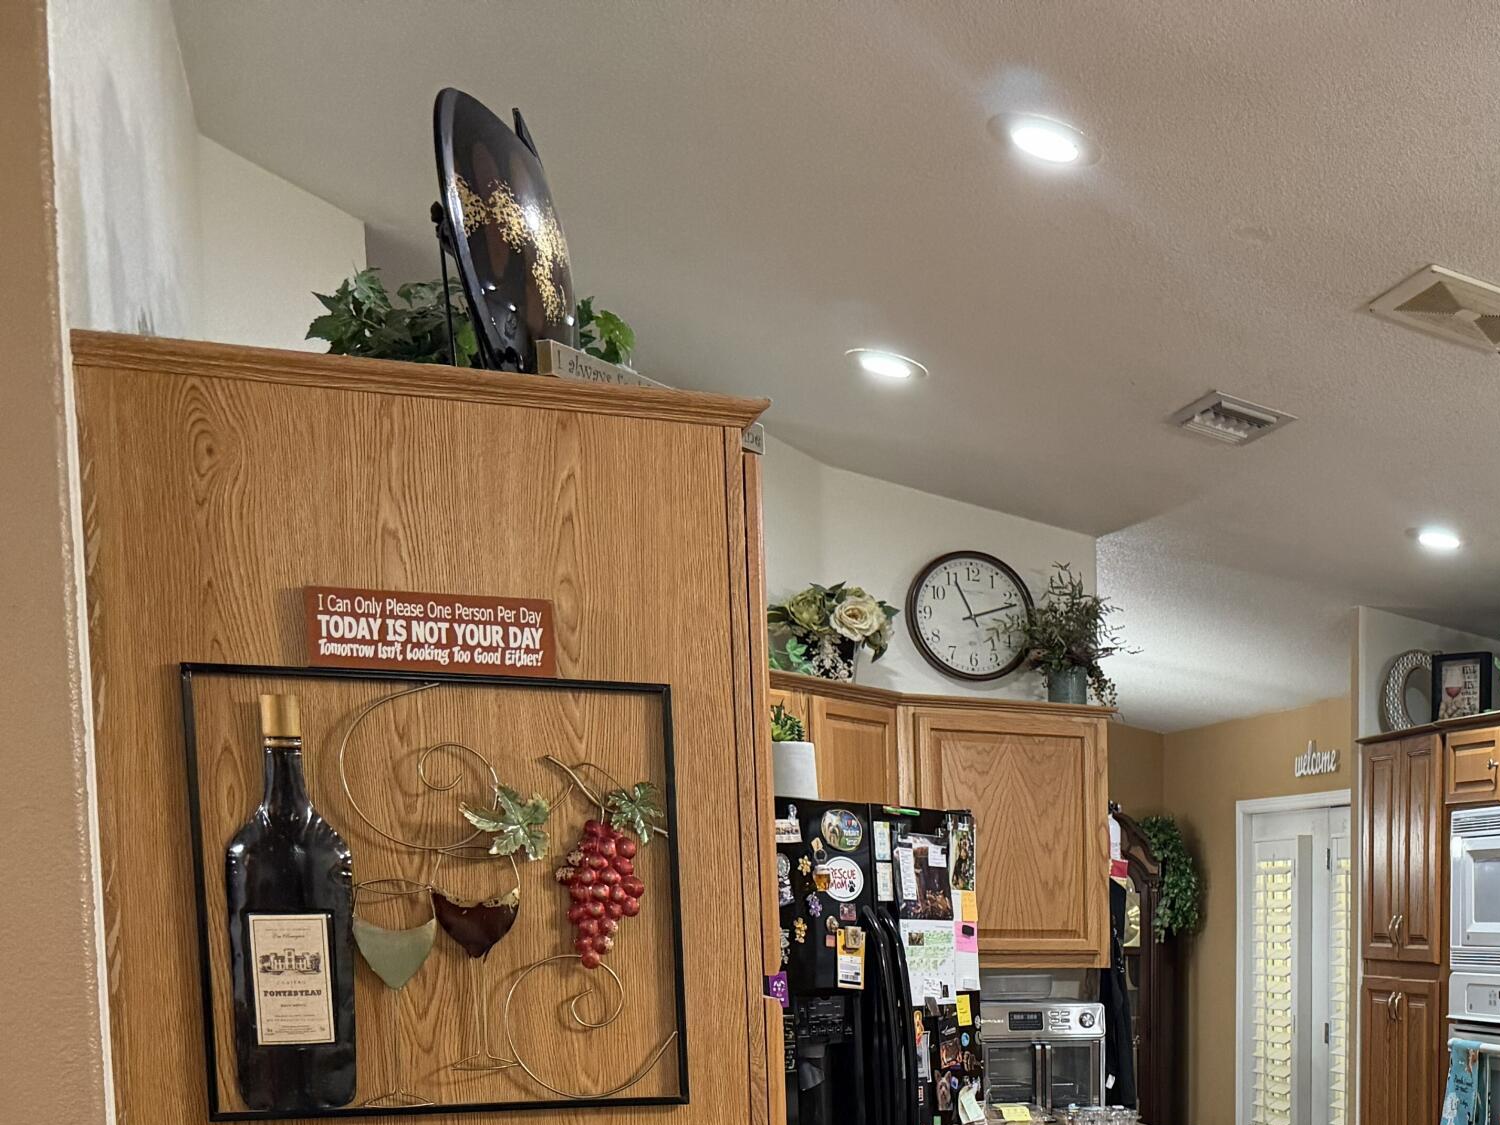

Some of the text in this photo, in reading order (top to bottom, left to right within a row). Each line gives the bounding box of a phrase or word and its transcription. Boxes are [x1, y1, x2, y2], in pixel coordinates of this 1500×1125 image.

[966, 567, 981, 582] 12
[989, 574, 995, 589] 1
[931, 585, 946, 600] 10
[317, 593, 542, 629] I Can Only Please One Person Per Day
[923, 605, 933, 620] 9
[316, 614, 544, 650] TODAY IS NOT YOUR DAY
[931, 629, 941, 643] 8
[318, 638, 544, 668] Tomorrow Isn't Looking Too Good Either!
[948, 645, 957, 661] 7
[969, 651, 979, 667] 6
[1294, 739, 1337, 778] welcome
